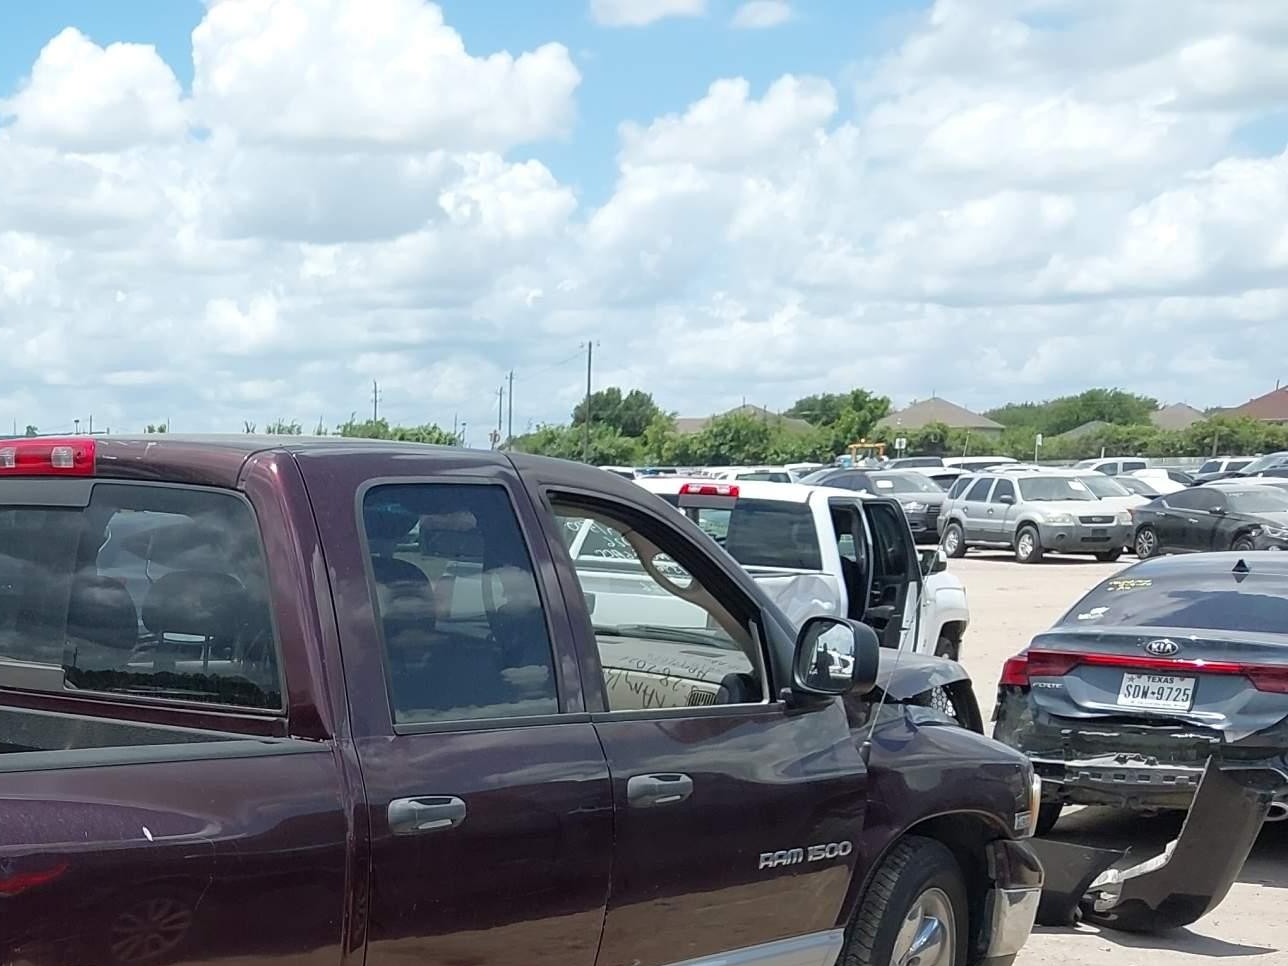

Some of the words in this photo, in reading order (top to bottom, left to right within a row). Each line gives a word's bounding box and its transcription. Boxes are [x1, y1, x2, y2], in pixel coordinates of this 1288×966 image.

[1150, 642, 1174, 653] KIA
[1147, 675, 1175, 684] TEXAS
[758, 847, 804, 869] RAM
[807, 840, 852, 862] 1500
